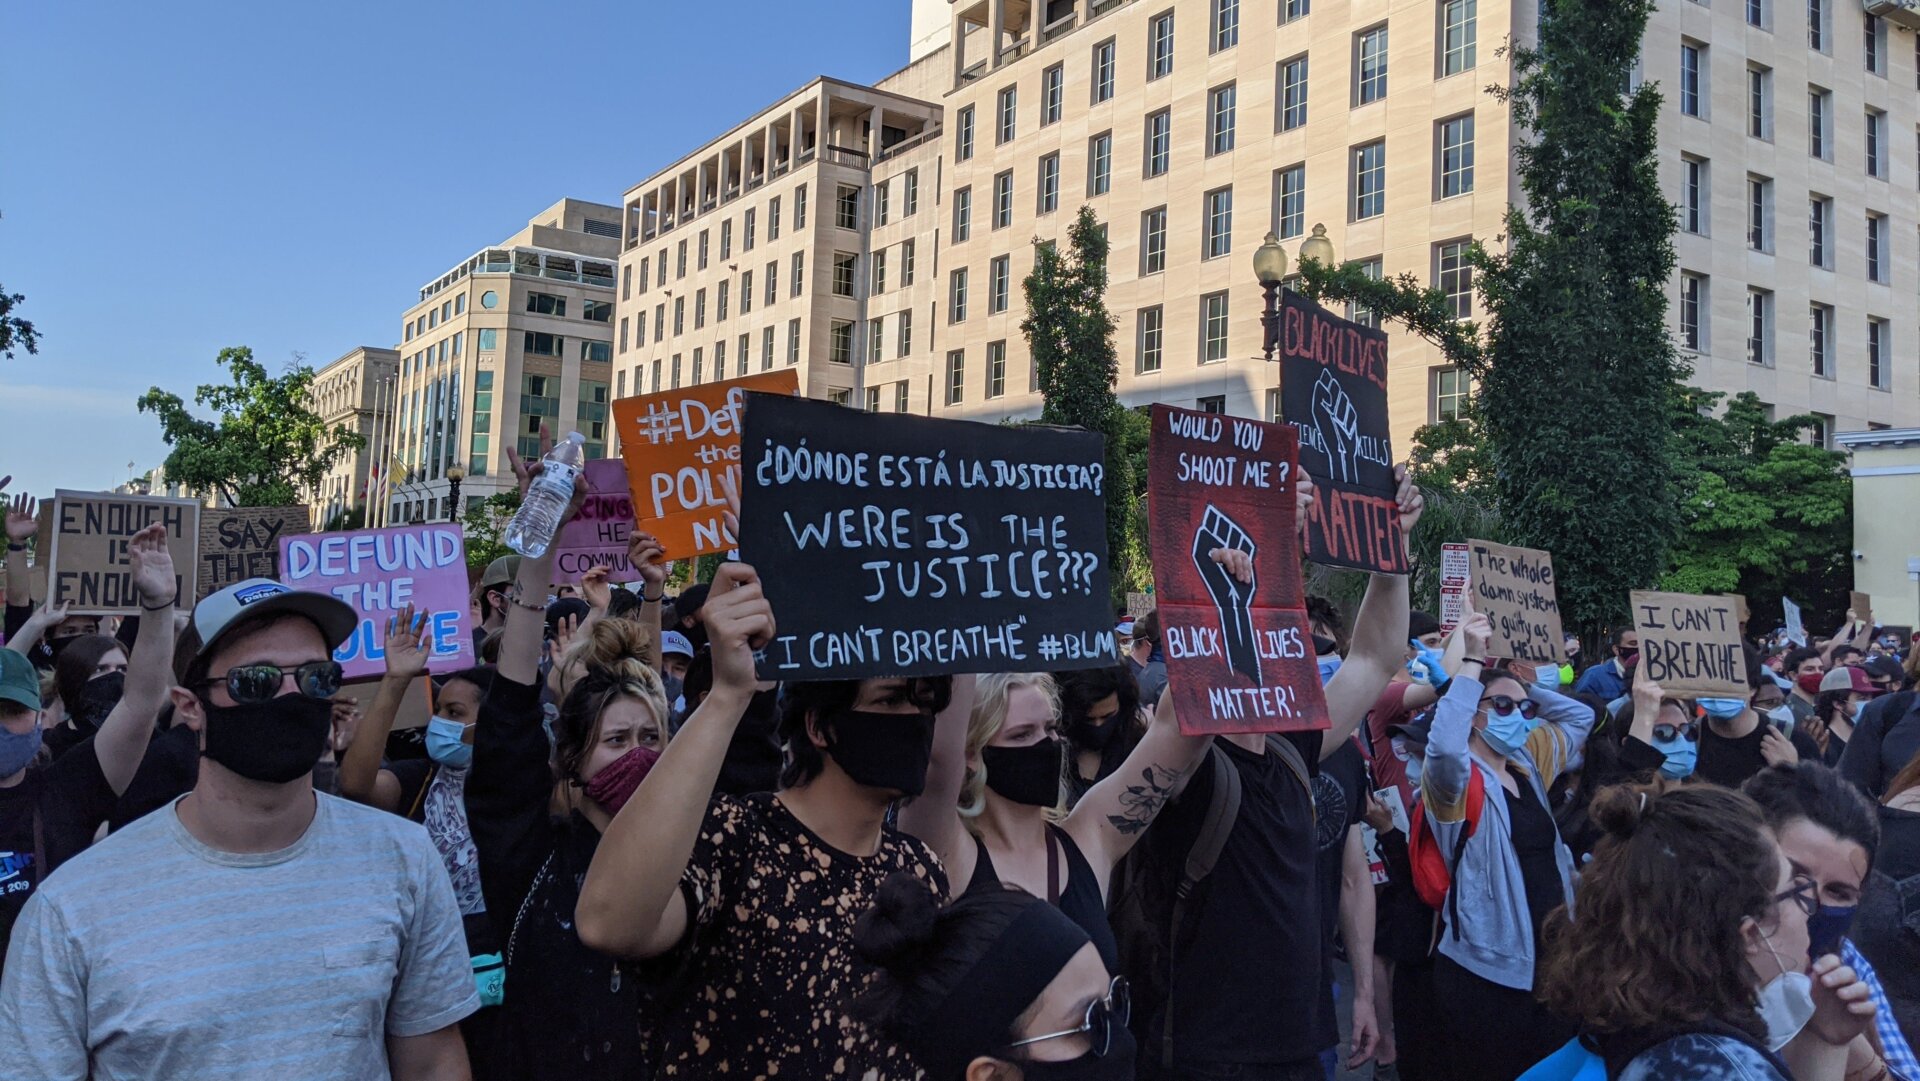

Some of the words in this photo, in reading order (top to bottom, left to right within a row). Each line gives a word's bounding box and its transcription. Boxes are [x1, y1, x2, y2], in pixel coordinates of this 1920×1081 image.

[1285, 306, 1337, 365] BLACK
[1338, 329, 1387, 391] LIVES
[637, 386, 742, 445] #Def
[1168, 411, 1222, 443] WOULD
[1233, 420, 1264, 452] YOU
[694, 444, 741, 464] the
[1177, 452, 1237, 487] SHOOT
[1242, 461, 1272, 488] ME
[1357, 435, 1389, 467] KILLS
[651, 465, 739, 519] POLI
[879, 449, 951, 488] ESTÁ
[959, 459, 989, 489] LA
[990, 459, 1103, 497] JUSTICIA?
[218, 517, 284, 550] SAY
[783, 505, 912, 550] WERE
[925, 512, 970, 550] IS
[1000, 514, 1068, 550] THE
[287, 529, 461, 580] DEFUND
[1474, 546, 1507, 575] The
[1510, 555, 1552, 585] whole
[331, 577, 414, 611] THE
[861, 550, 1098, 603] JUSTICE???
[1479, 574, 1515, 603] damn
[1516, 589, 1557, 614] system
[1484, 607, 1496, 631] is
[1534, 624, 1549, 643] as
[1640, 605, 1665, 629] I
[1672, 606, 1728, 632] CAN'T
[809, 624, 884, 668] CAN'T
[1038, 630, 1117, 662] #BLM
[1167, 626, 1222, 659] BLACK
[1256, 627, 1305, 659] LIVES
[1510, 640, 1556, 661] HELL!
[1644, 638, 1745, 684] BREATHE
[1208, 685, 1301, 720] MATTER!
